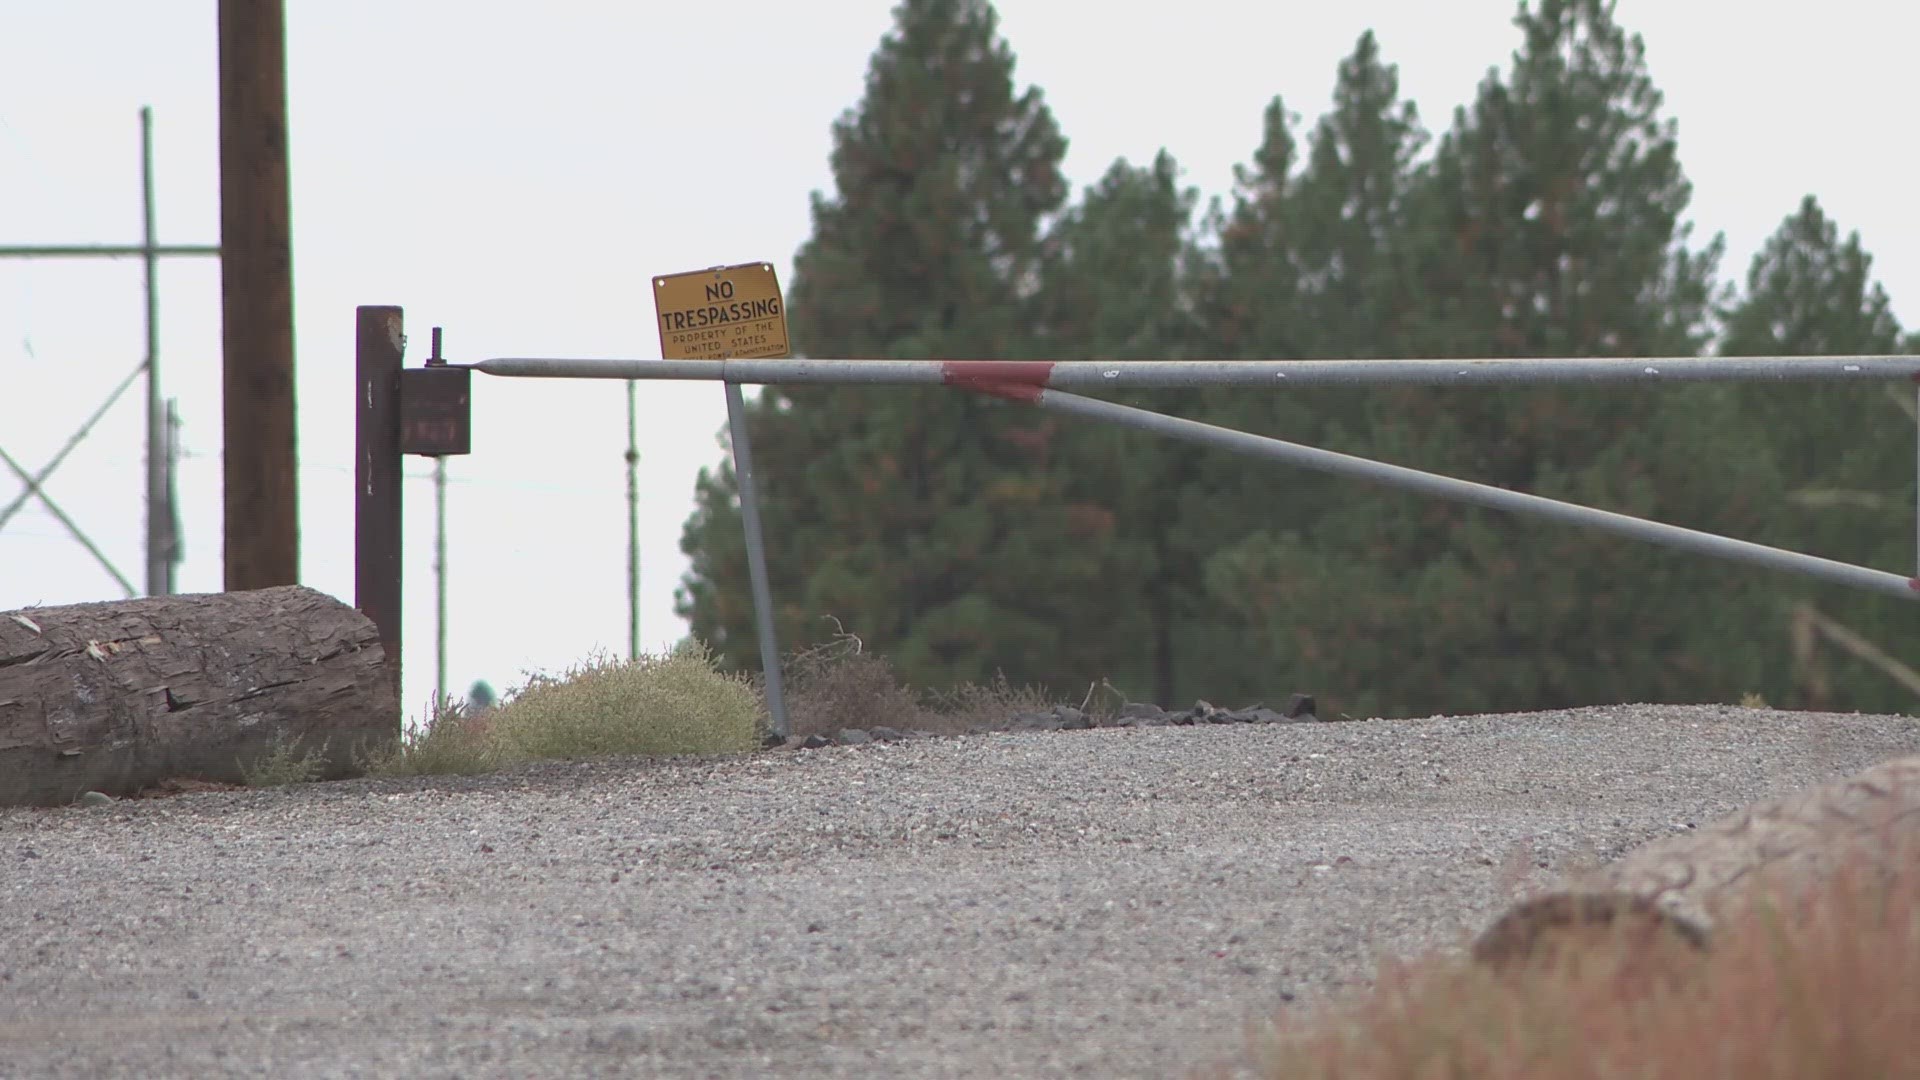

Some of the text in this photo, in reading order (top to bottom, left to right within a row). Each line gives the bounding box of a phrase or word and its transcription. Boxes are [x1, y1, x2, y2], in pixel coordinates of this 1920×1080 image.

[705, 281, 734, 301] NO
[661, 298, 779, 330] TRESPASSING
[672, 321, 774, 344] PROPERTY OF THE
[684, 334, 766, 353] UNITED STATES
